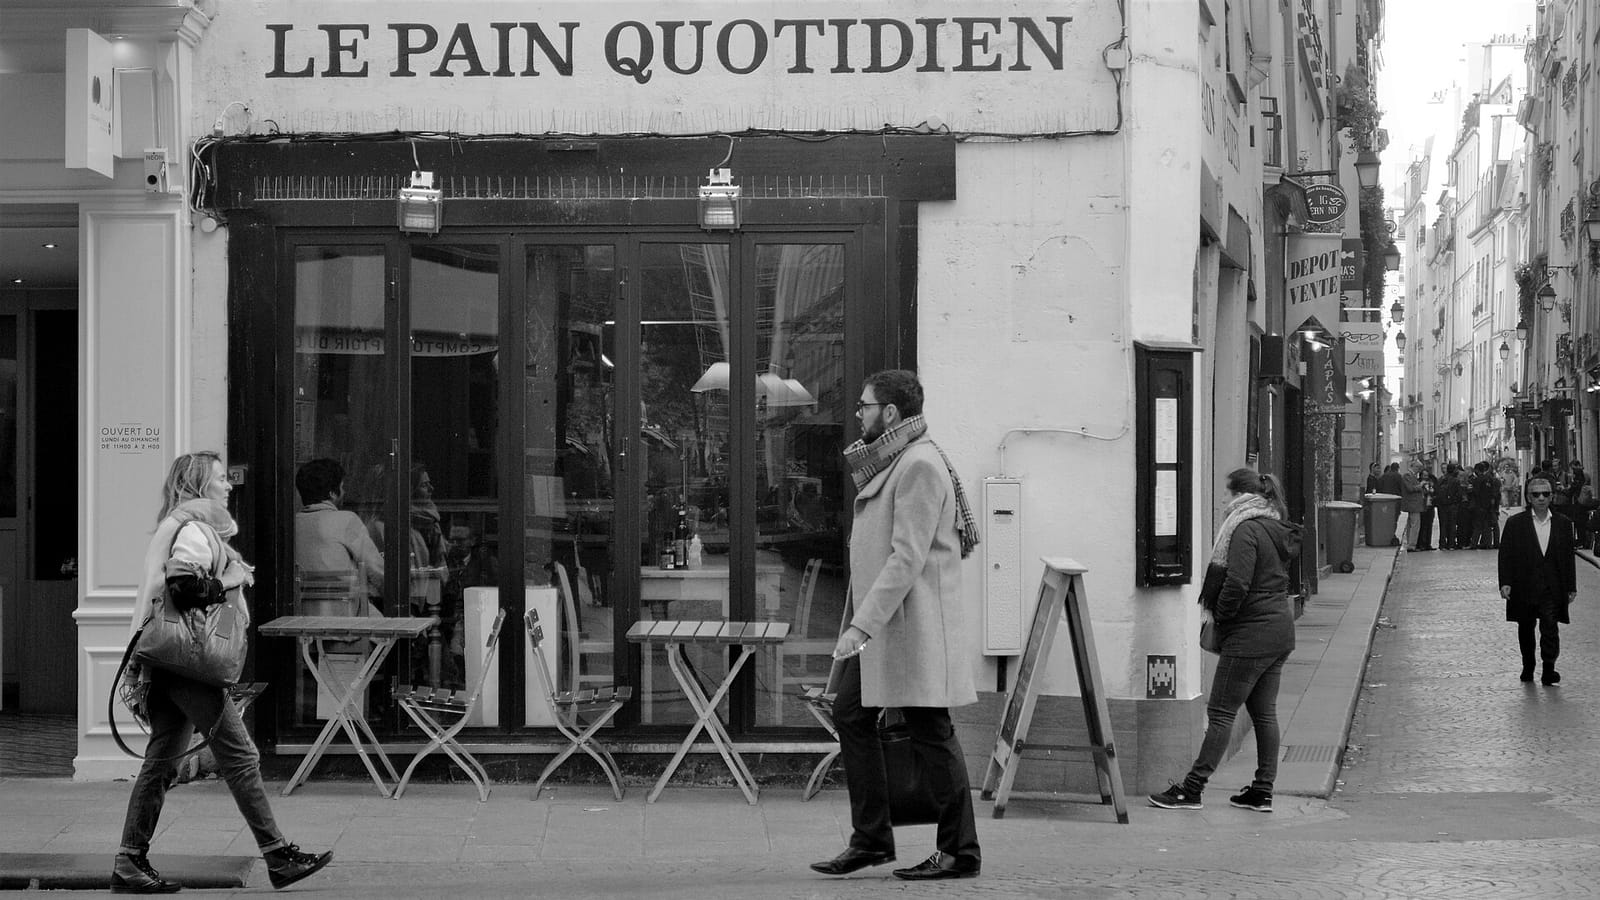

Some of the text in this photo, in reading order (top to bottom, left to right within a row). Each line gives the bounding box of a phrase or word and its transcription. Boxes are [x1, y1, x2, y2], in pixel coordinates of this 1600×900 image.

[266, 16, 1073, 85] LE PAIN QUOTIDIEN
[1290, 249, 1339, 281] DEPOT
[1289, 275, 1338, 305] VENTE
[1324, 347, 1334, 403] TAPAS
[101, 427, 160, 436] OUVERT DU
